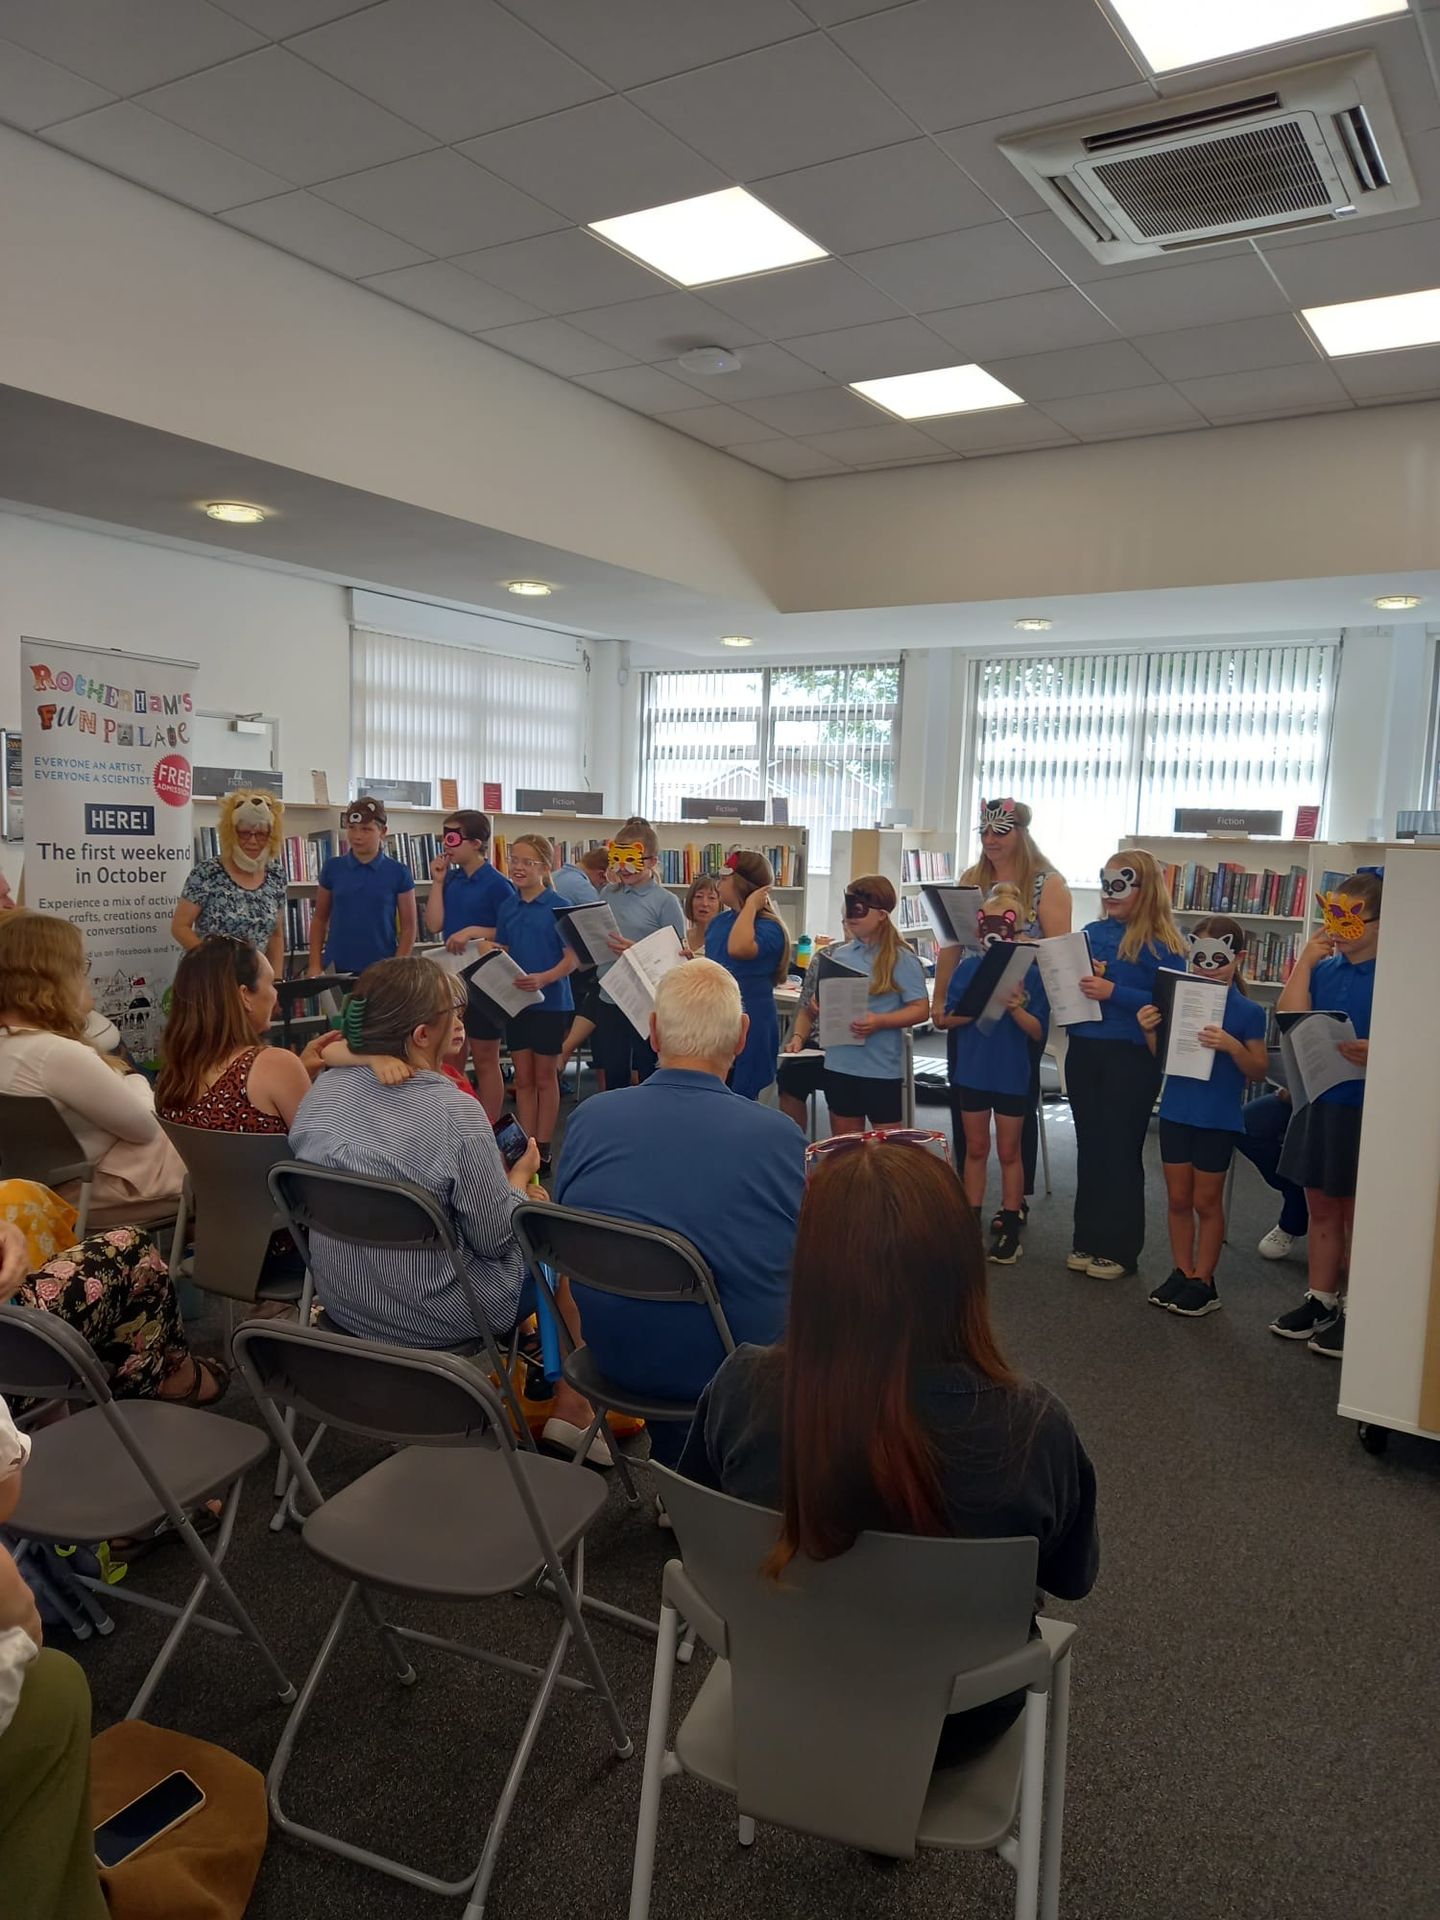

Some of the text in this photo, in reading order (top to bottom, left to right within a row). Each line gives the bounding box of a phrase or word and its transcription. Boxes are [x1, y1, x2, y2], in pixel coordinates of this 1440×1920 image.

[37, 704, 97, 734] FUN
[34, 756, 90, 769] EVERYONE
[93, 761, 106, 770] AN
[34, 770, 90, 782] EVERYONE
[102, 775, 151, 785] SCIENTIST
[158, 764, 191, 789] FREE
[552, 797, 576, 806] Fiction
[715, 805, 738, 813] Fiction
[91, 810, 148, 830] HERE!
[1217, 816, 1245, 826] Fiction
[36, 843, 191, 860] The first weekend
[76, 866, 167, 884] in October
[38, 898, 100, 911] Experience
[112, 898, 131, 906] mix
[134, 896, 145, 906] of
[103, 910, 151, 921] creations
[154, 909, 173, 919] and
[86, 924, 158, 937] conversations
[116, 947, 151, 957] Facebook
